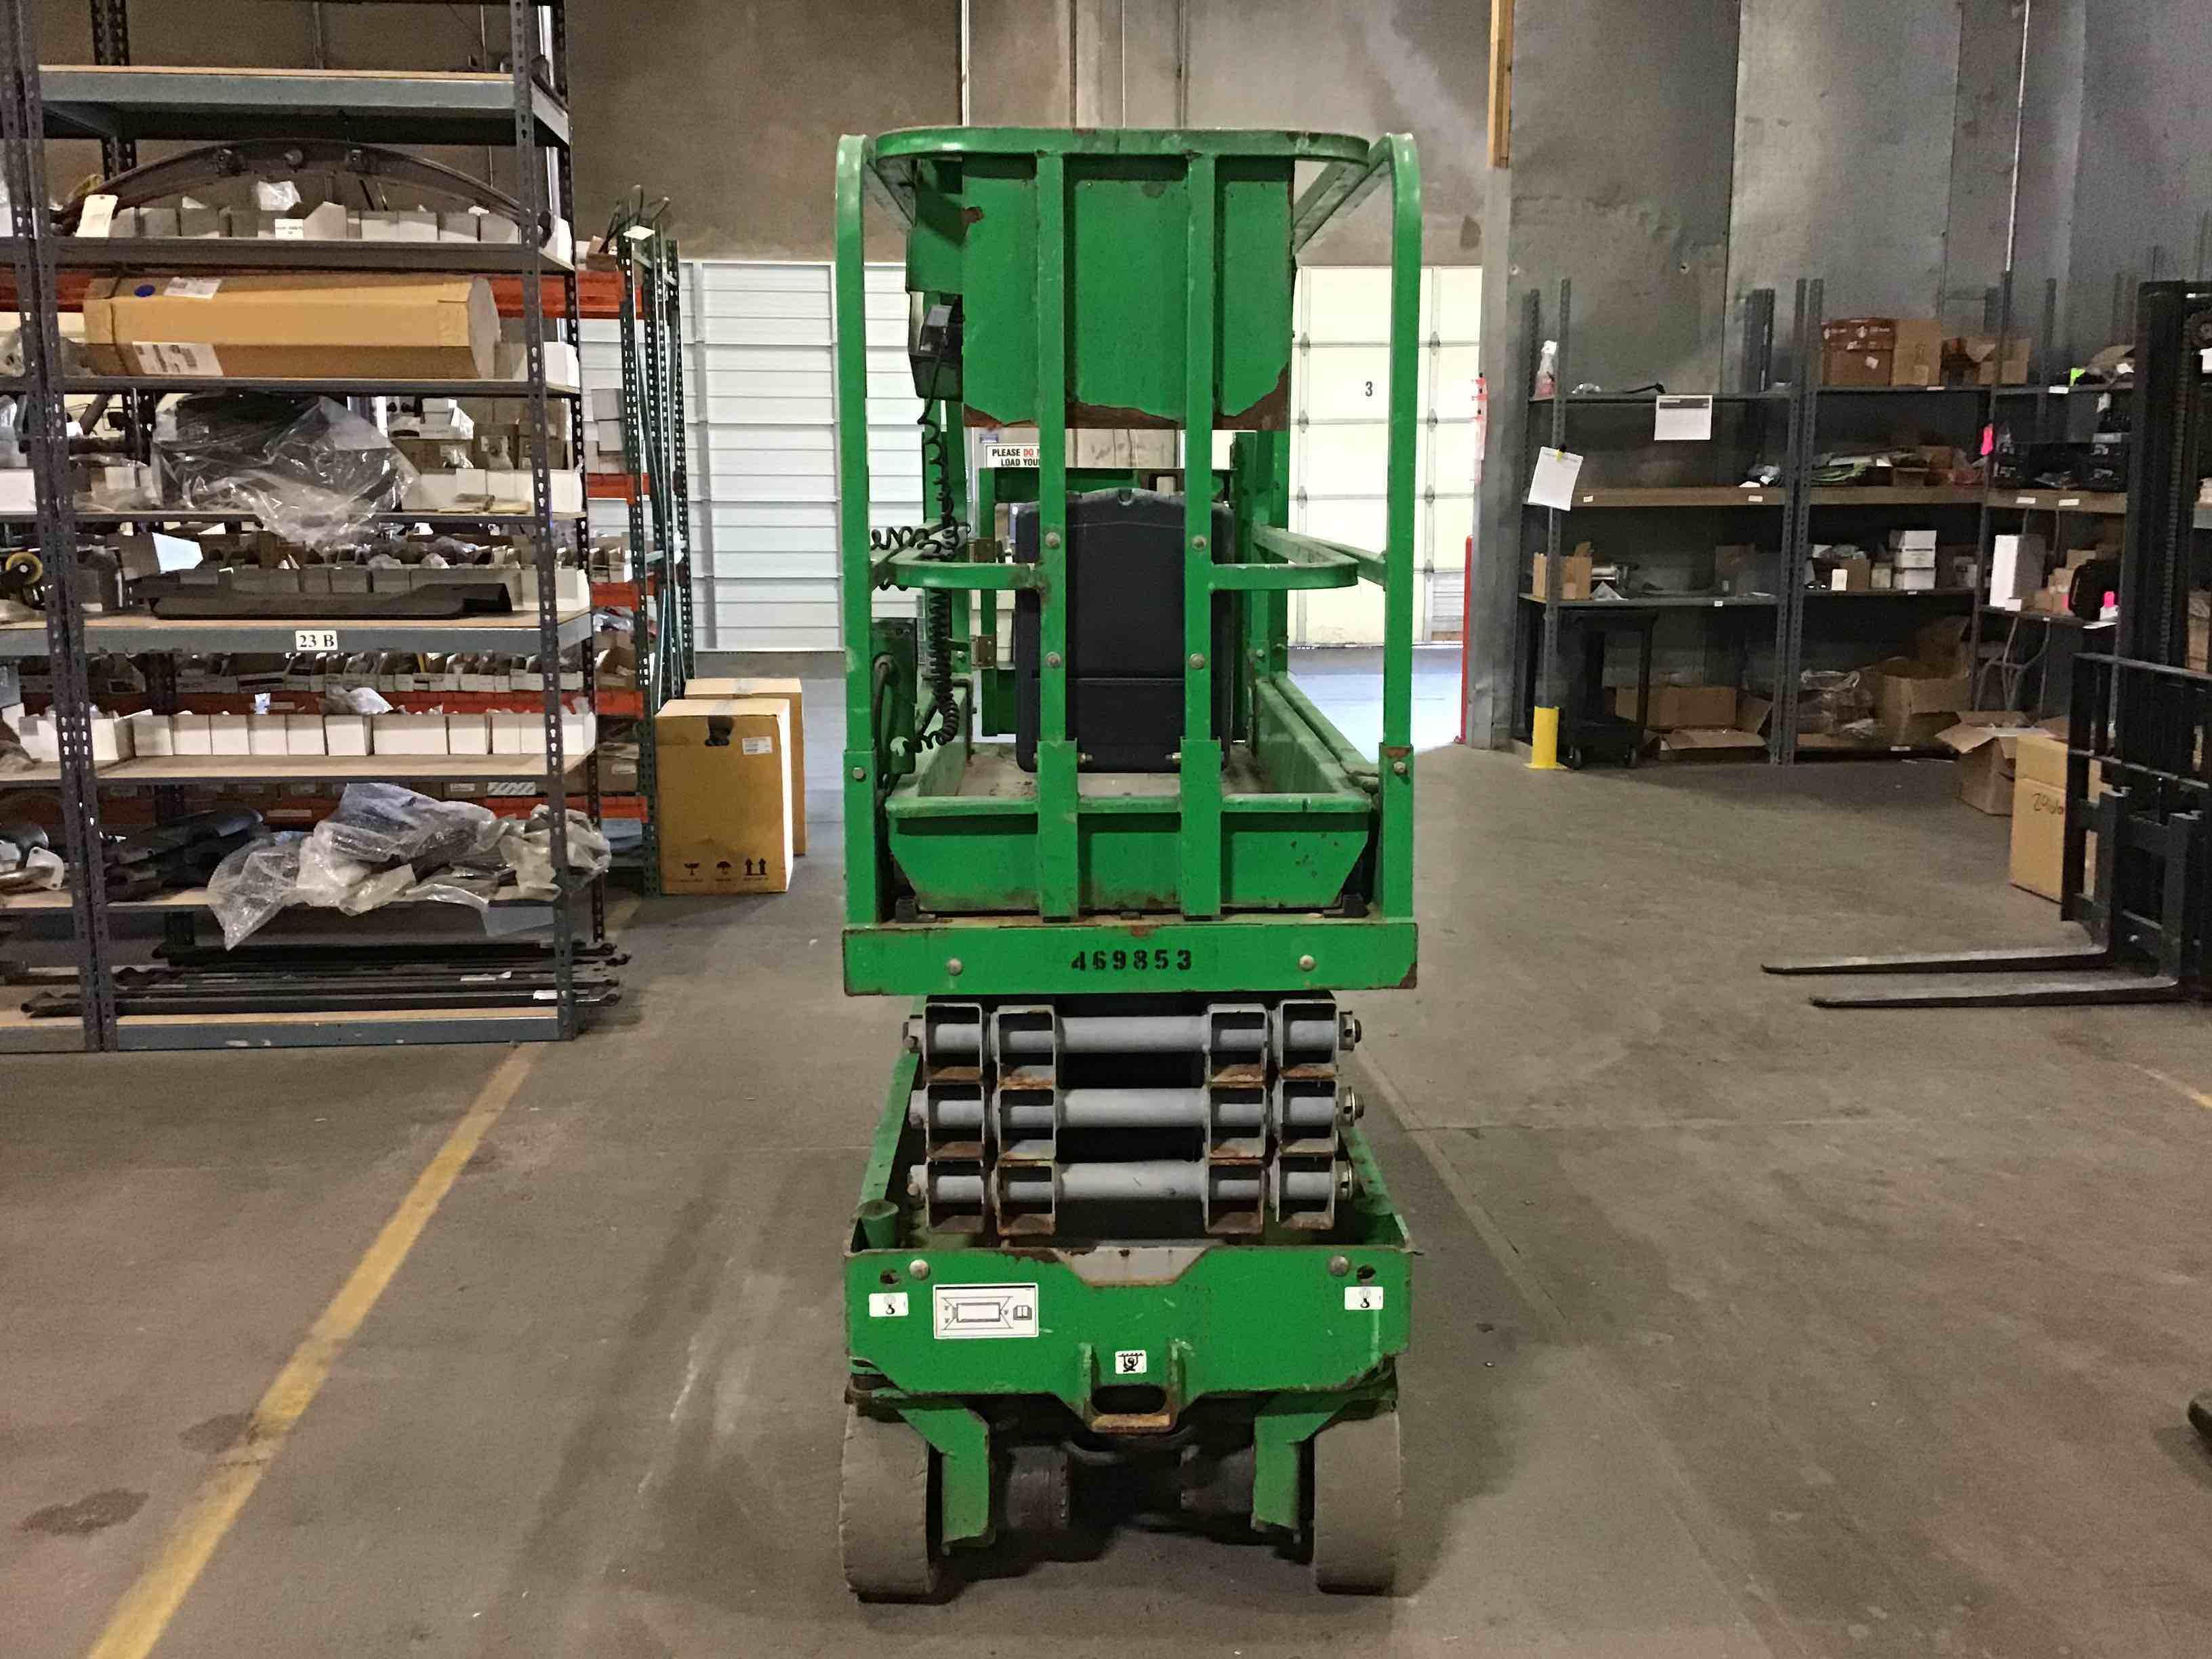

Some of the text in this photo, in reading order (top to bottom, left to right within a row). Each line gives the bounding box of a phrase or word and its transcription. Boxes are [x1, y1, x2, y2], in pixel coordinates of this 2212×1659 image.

[1365, 381, 1373, 397] 3
[1023, 449, 1033, 457] DO
[1001, 458, 1021, 466] LOAD
[299, 634, 334, 647] 23 B
[1071, 949, 1191, 970] 469853
